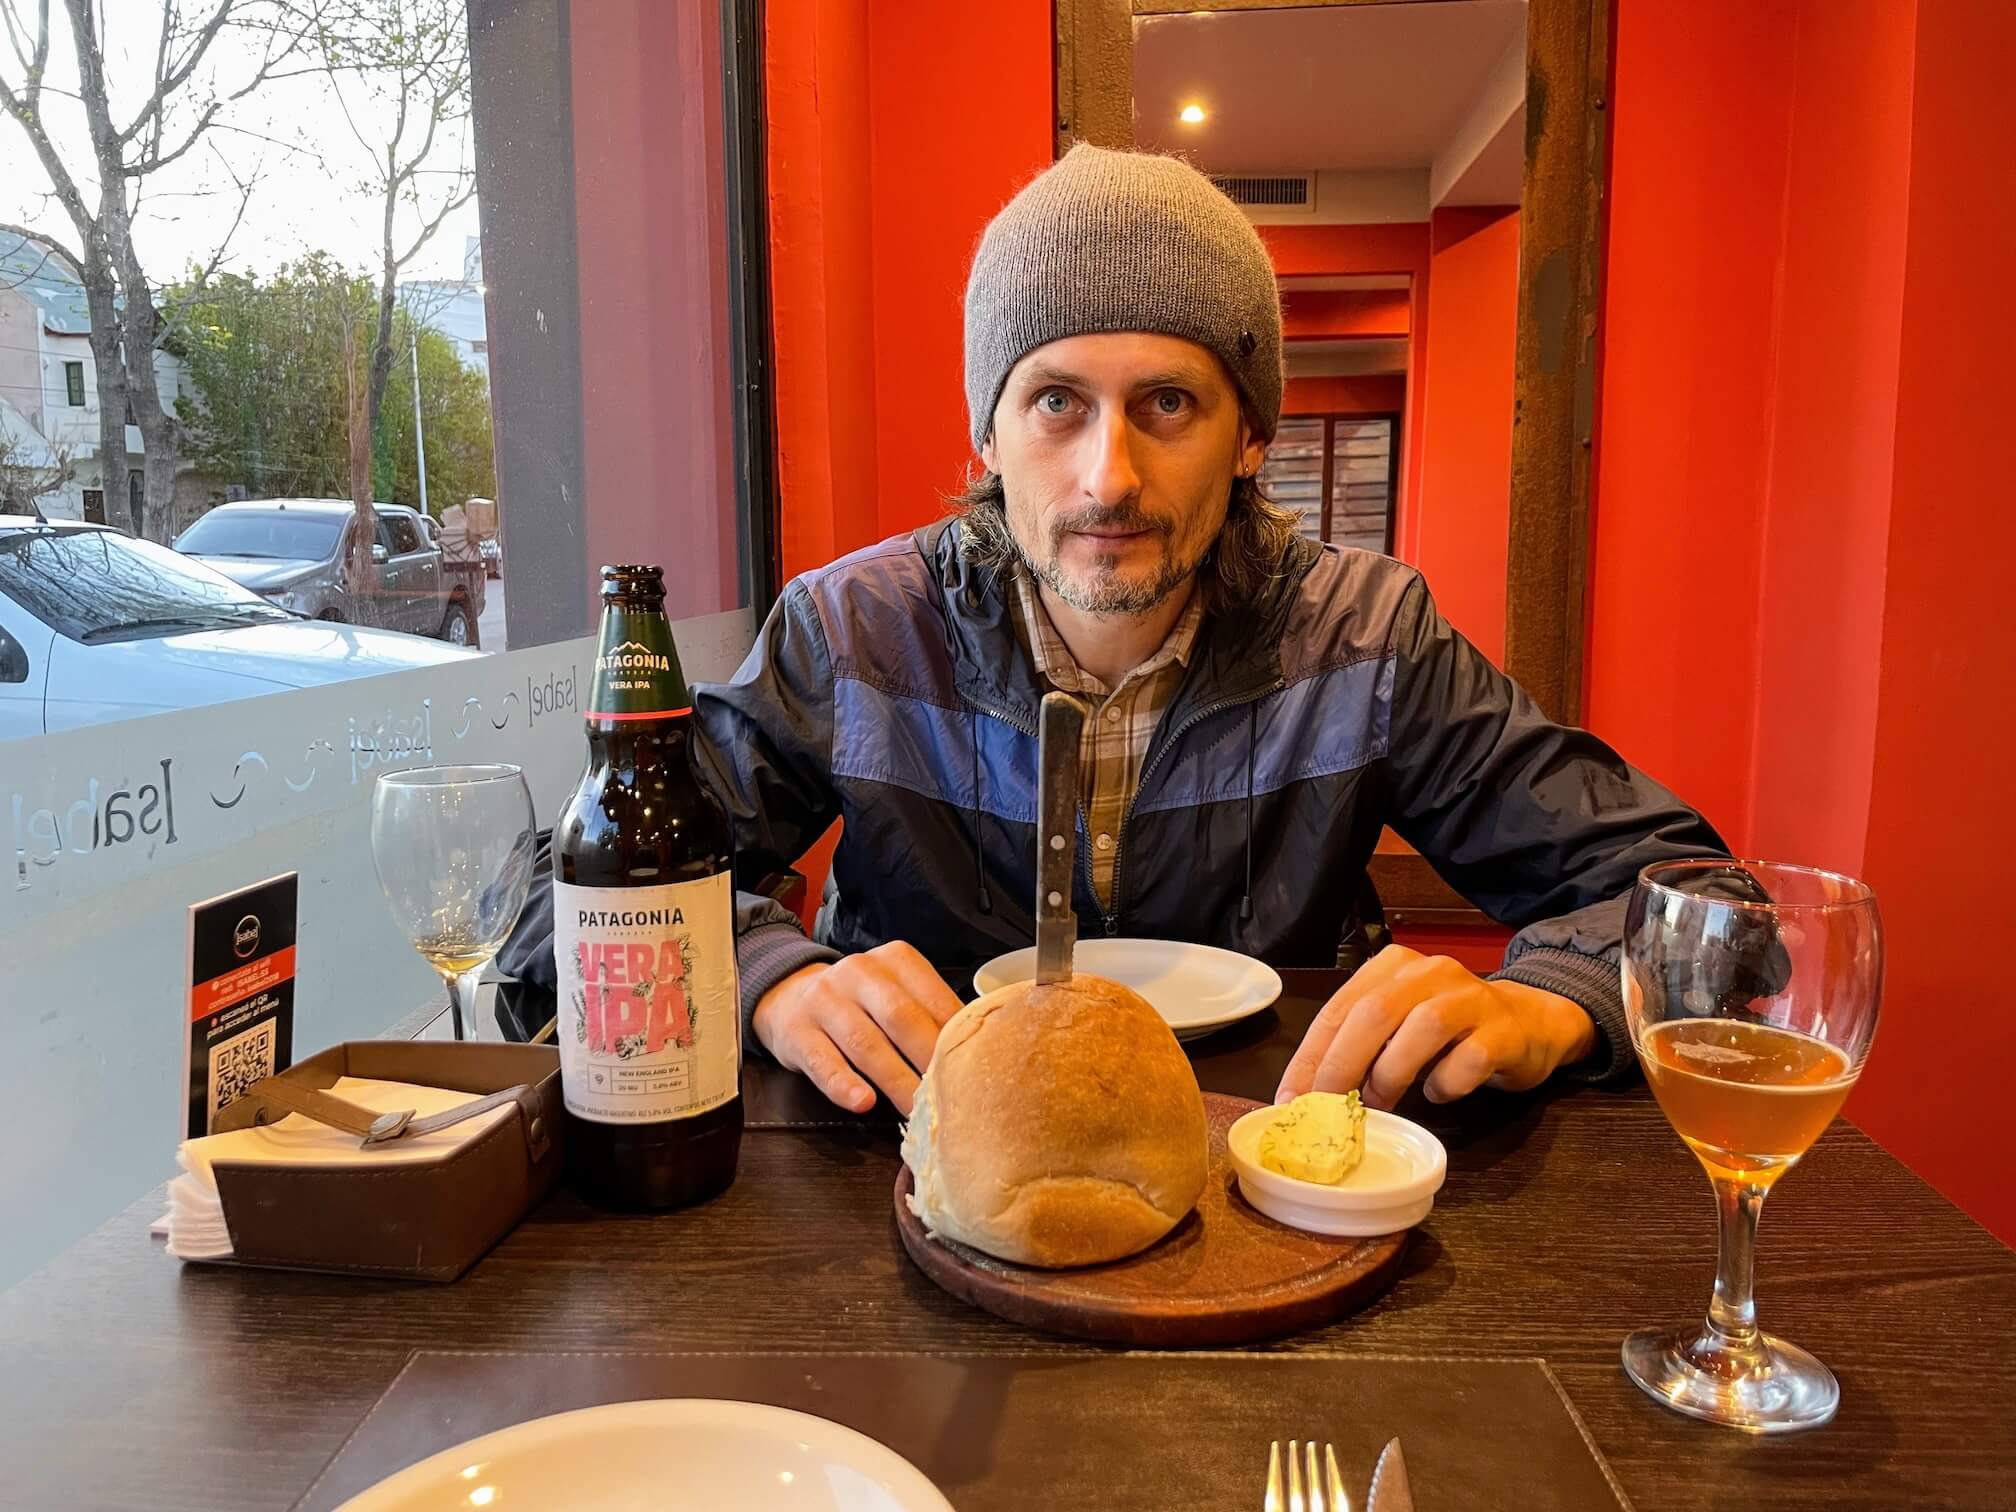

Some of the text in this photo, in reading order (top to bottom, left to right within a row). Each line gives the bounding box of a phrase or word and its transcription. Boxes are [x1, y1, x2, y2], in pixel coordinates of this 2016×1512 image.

[609, 680, 650, 689] VERA IPA
[579, 907, 684, 927] PATAGONIA
[578, 940, 684, 984] VERA
[257, 994, 268, 1005] QR
[585, 982, 693, 1056] IPA
[636, 1068, 667, 1077] ENGLAND
